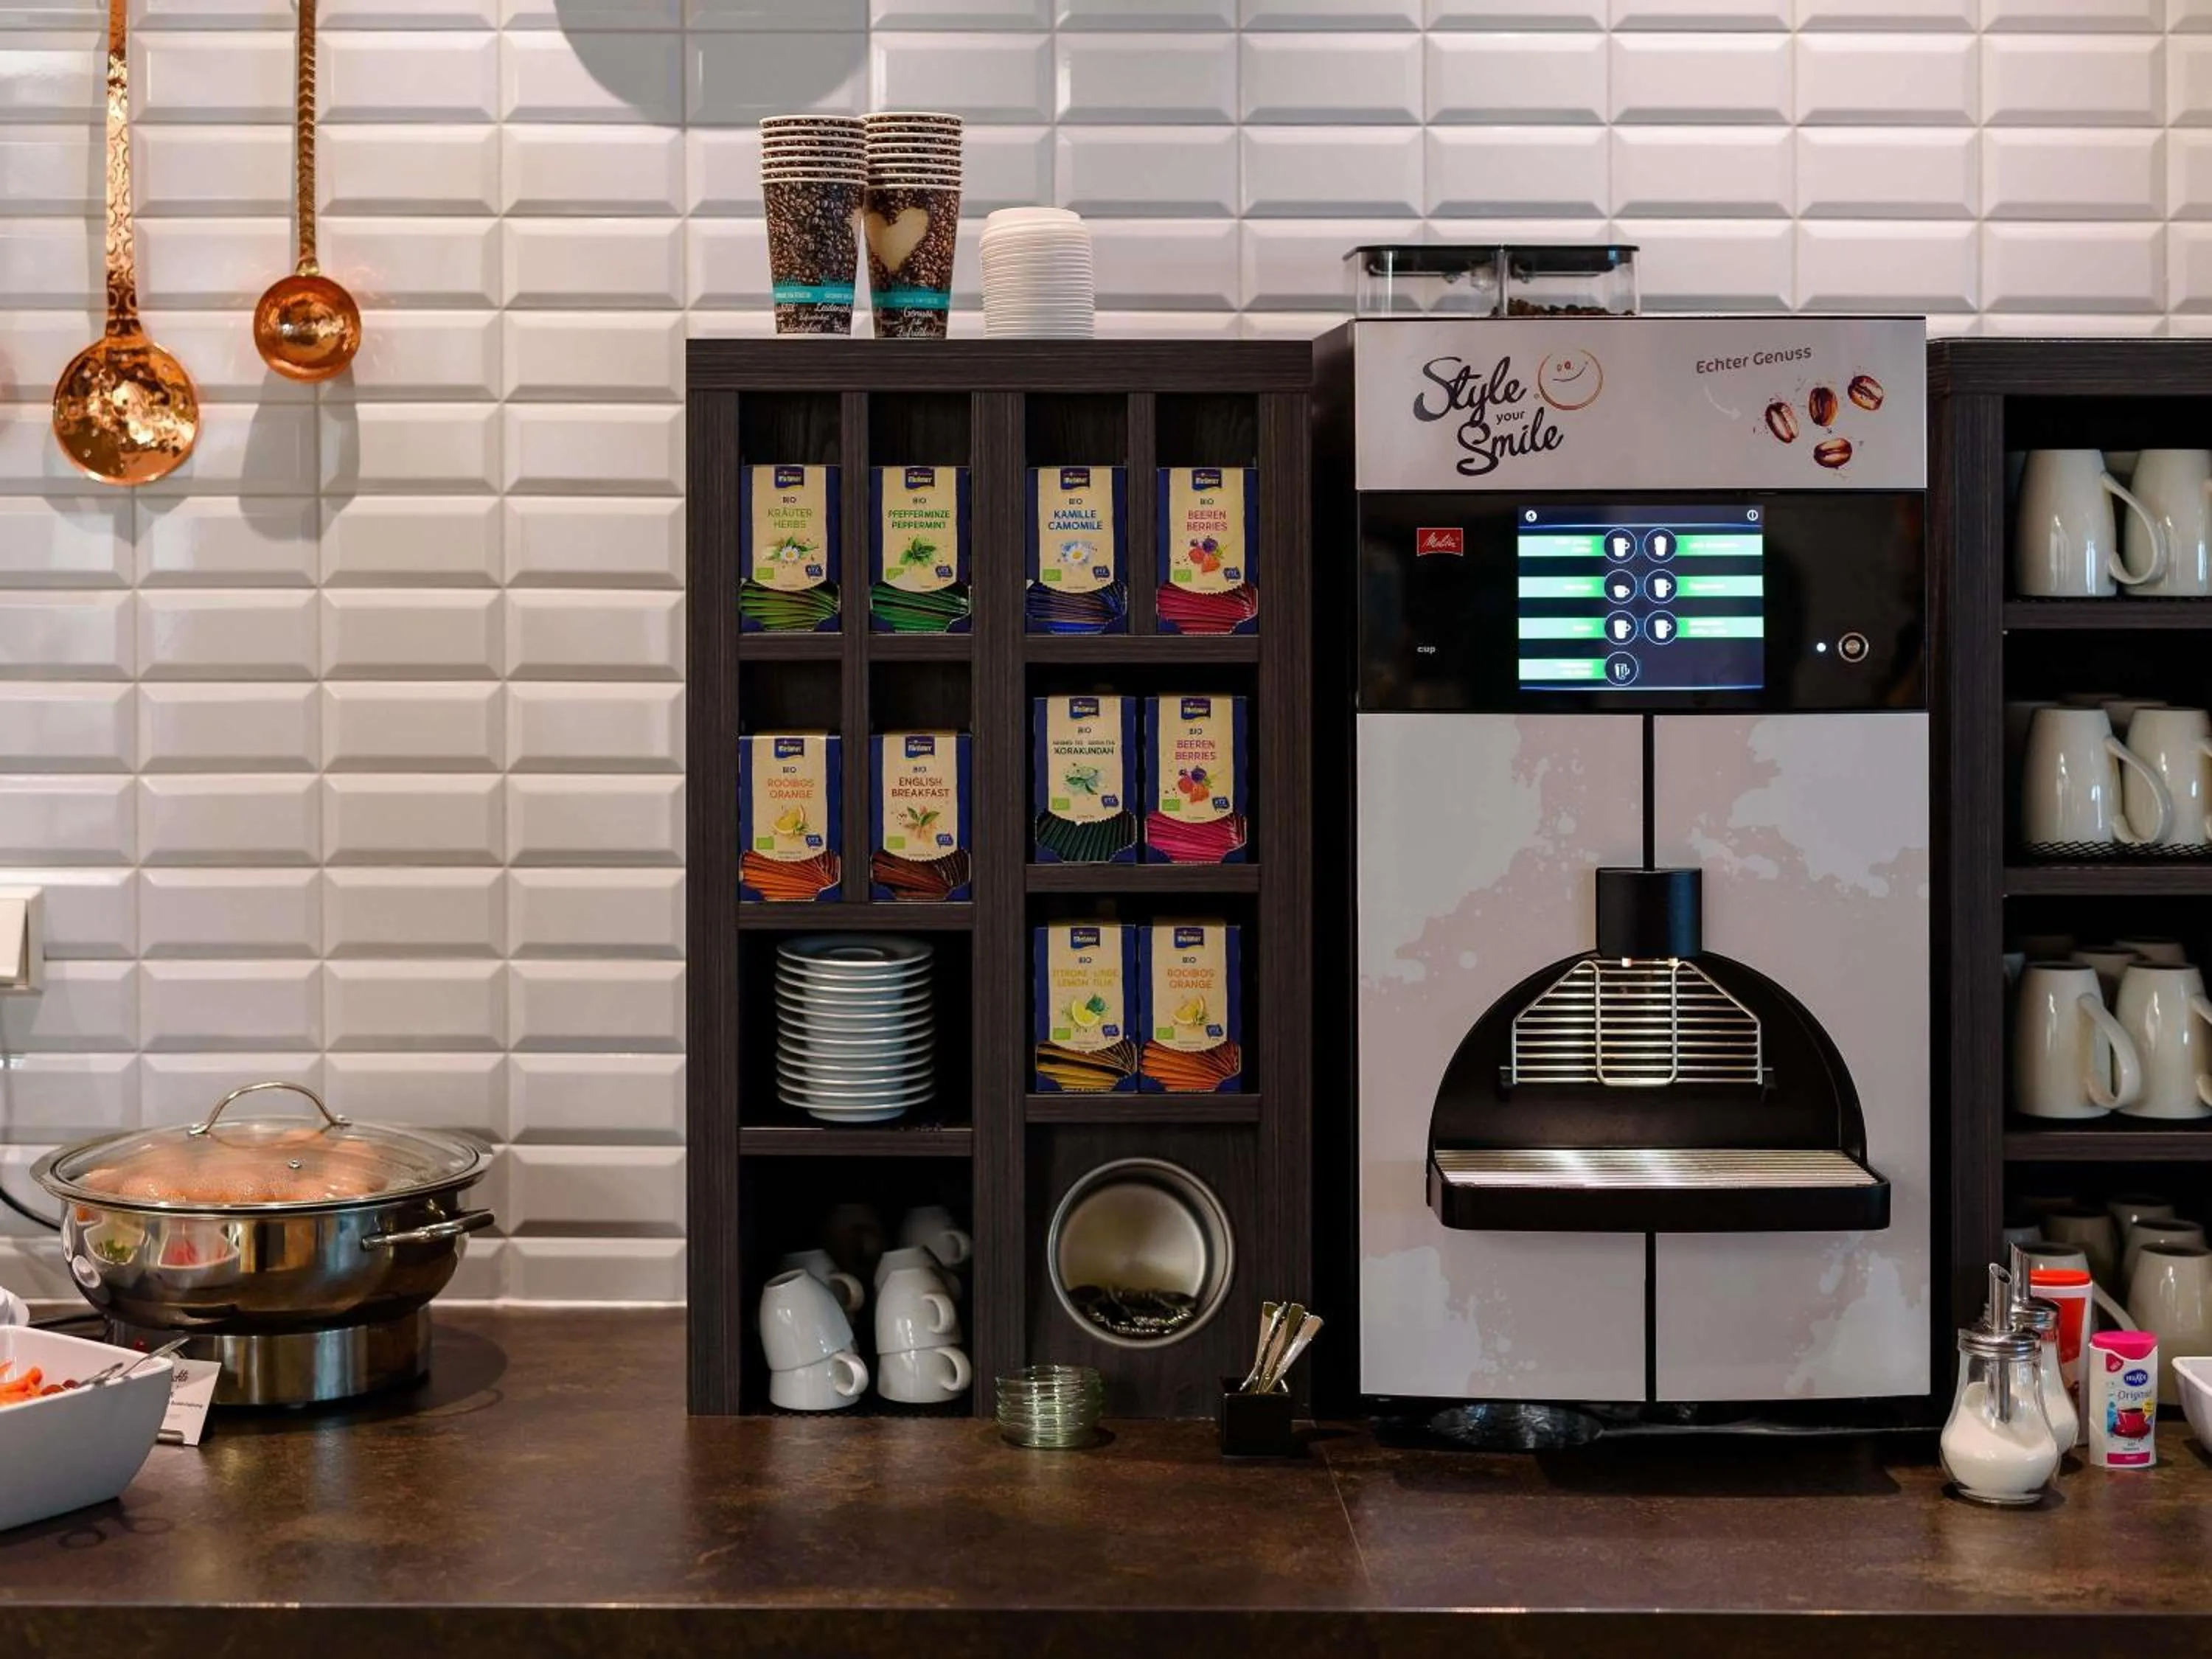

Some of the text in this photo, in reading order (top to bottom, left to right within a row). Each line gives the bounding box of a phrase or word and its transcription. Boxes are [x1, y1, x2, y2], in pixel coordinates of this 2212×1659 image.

[1696, 347, 1812, 374] Echter Genuss
[1413, 356, 1527, 422] Style
[1496, 409, 1526, 425] your
[1456, 406, 1564, 476] Smile
[1054, 509, 1096, 518] KAMILLE
[1188, 509, 1227, 520] BEEREN
[773, 520, 807, 529] HERBS
[891, 521, 946, 529] PEPPERMINT
[1048, 521, 1104, 530] CAMOMILE
[1186, 521, 1228, 532] BERRIES
[1416, 646, 1436, 655] cup
[1077, 726, 1092, 734] BIO
[1189, 727, 1203, 735] BIO
[1176, 740, 1216, 749] BEEREN
[1175, 751, 1217, 760] BERRIES
[899, 776, 943, 787] ENGLISH
[769, 790, 813, 799] ORANGE
[891, 788, 951, 797] BREAKFAST
[1078, 956, 1093, 964] BIO
[1182, 956, 1197, 964] BIO
[1169, 980, 1214, 990] ORANGE
